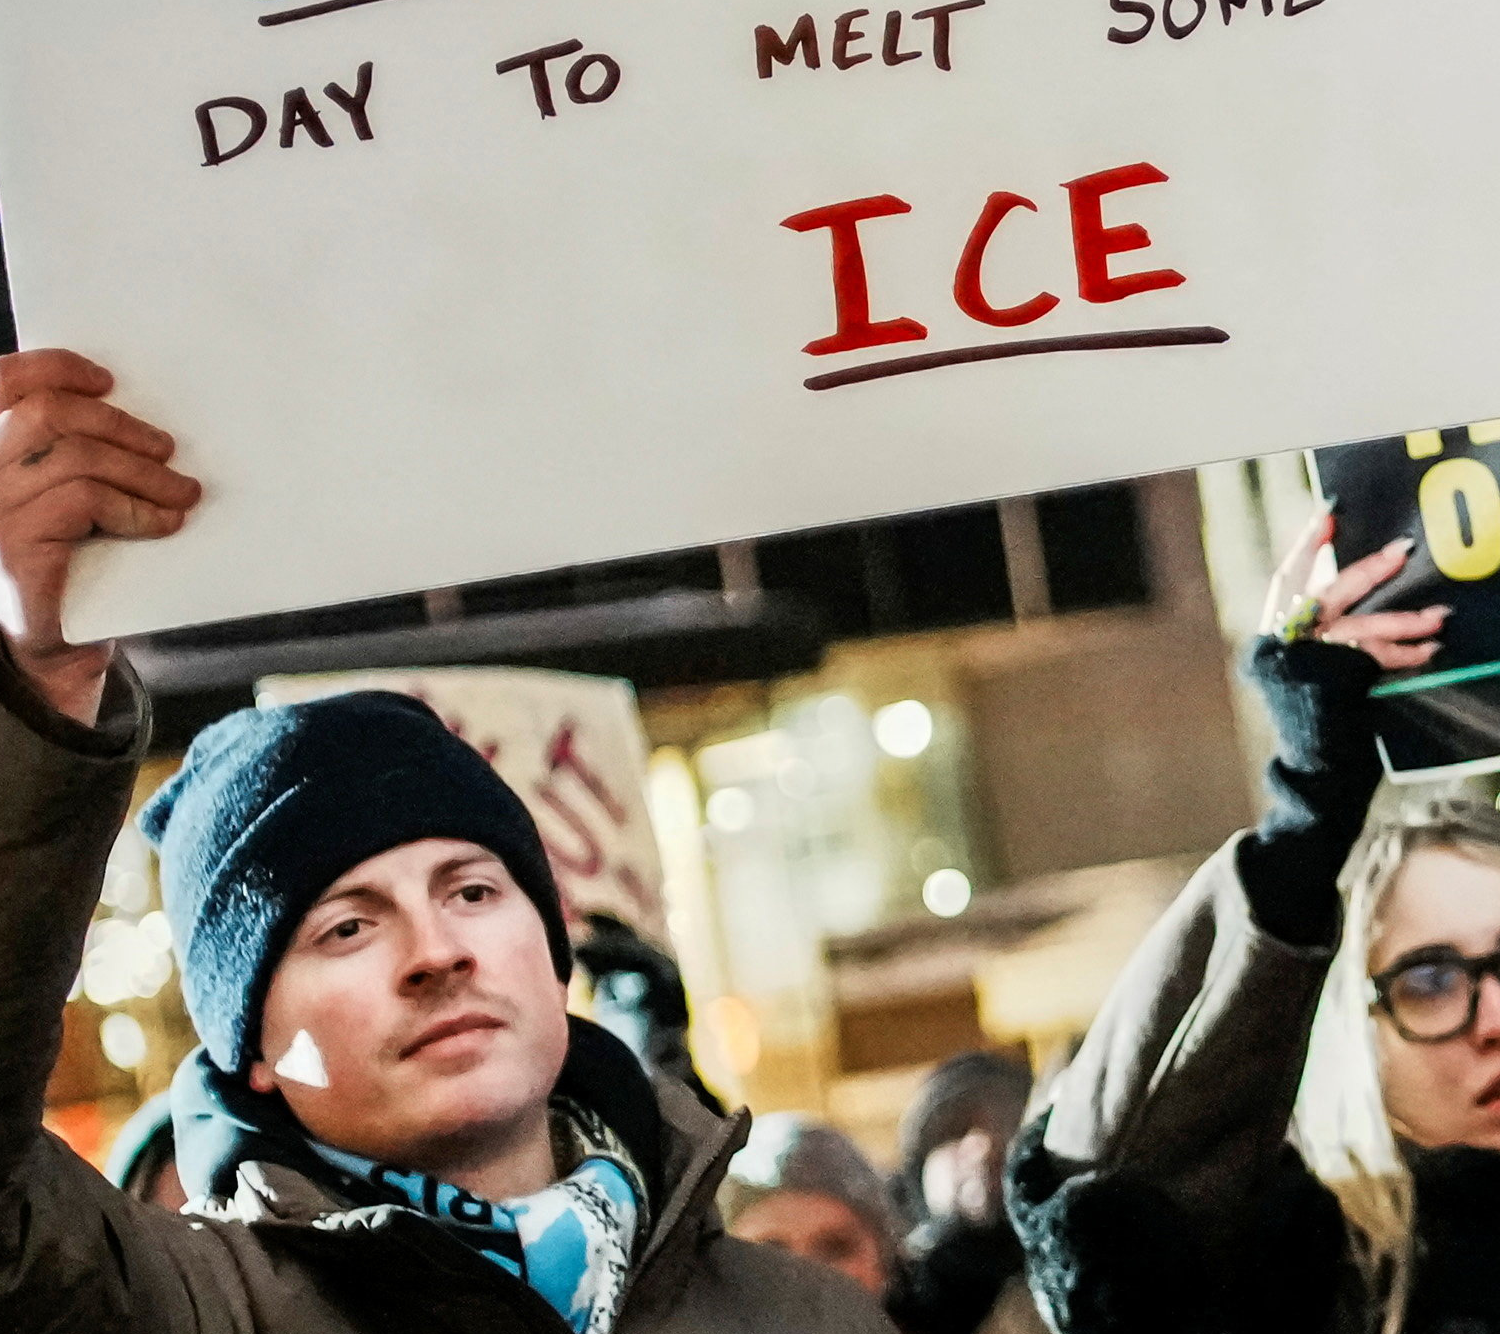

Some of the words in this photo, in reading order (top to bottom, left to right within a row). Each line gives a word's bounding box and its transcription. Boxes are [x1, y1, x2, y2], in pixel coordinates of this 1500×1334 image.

[193, 60, 375, 169] DAY
[495, 37, 622, 120] TO
[780, 161, 1187, 356] ICE
